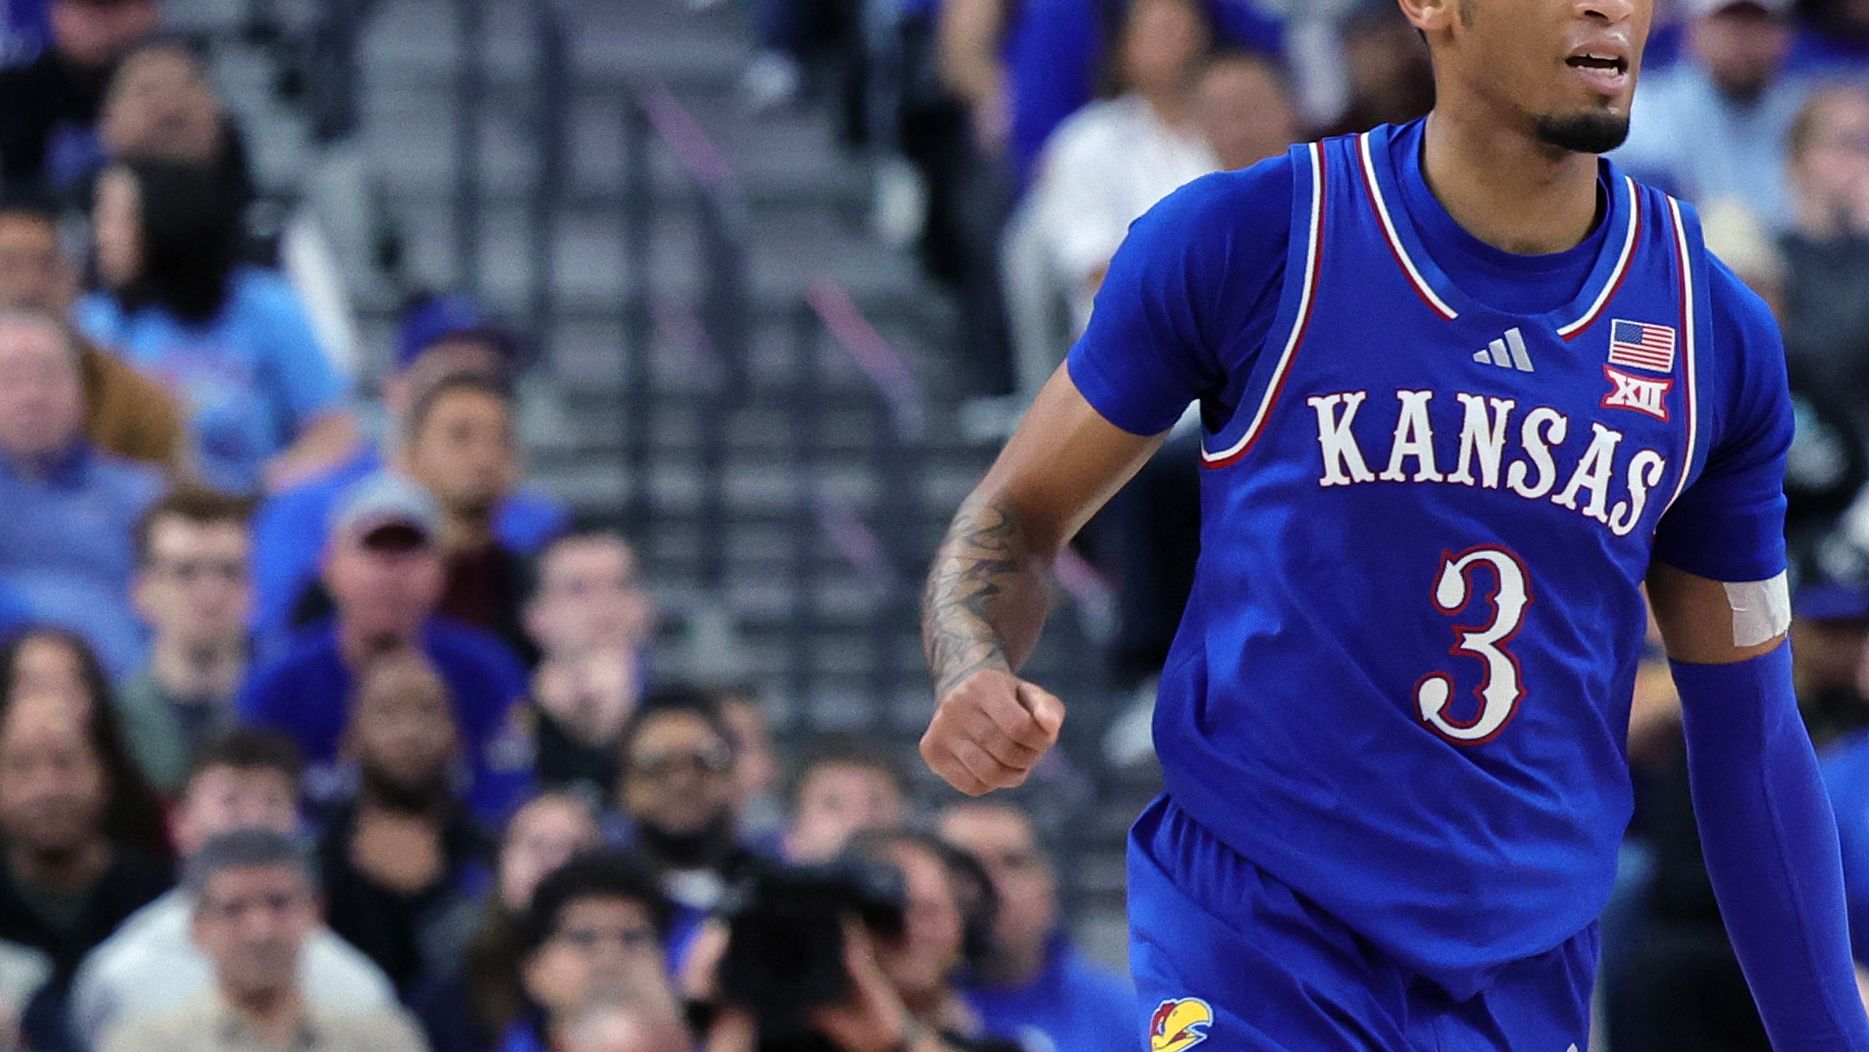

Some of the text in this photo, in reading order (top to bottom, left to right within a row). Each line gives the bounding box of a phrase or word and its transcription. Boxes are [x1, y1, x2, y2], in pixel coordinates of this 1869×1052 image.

[1306, 388, 1666, 538] KANSAS
[1604, 368, 1671, 420] XII
[1414, 545, 1533, 745] 3
